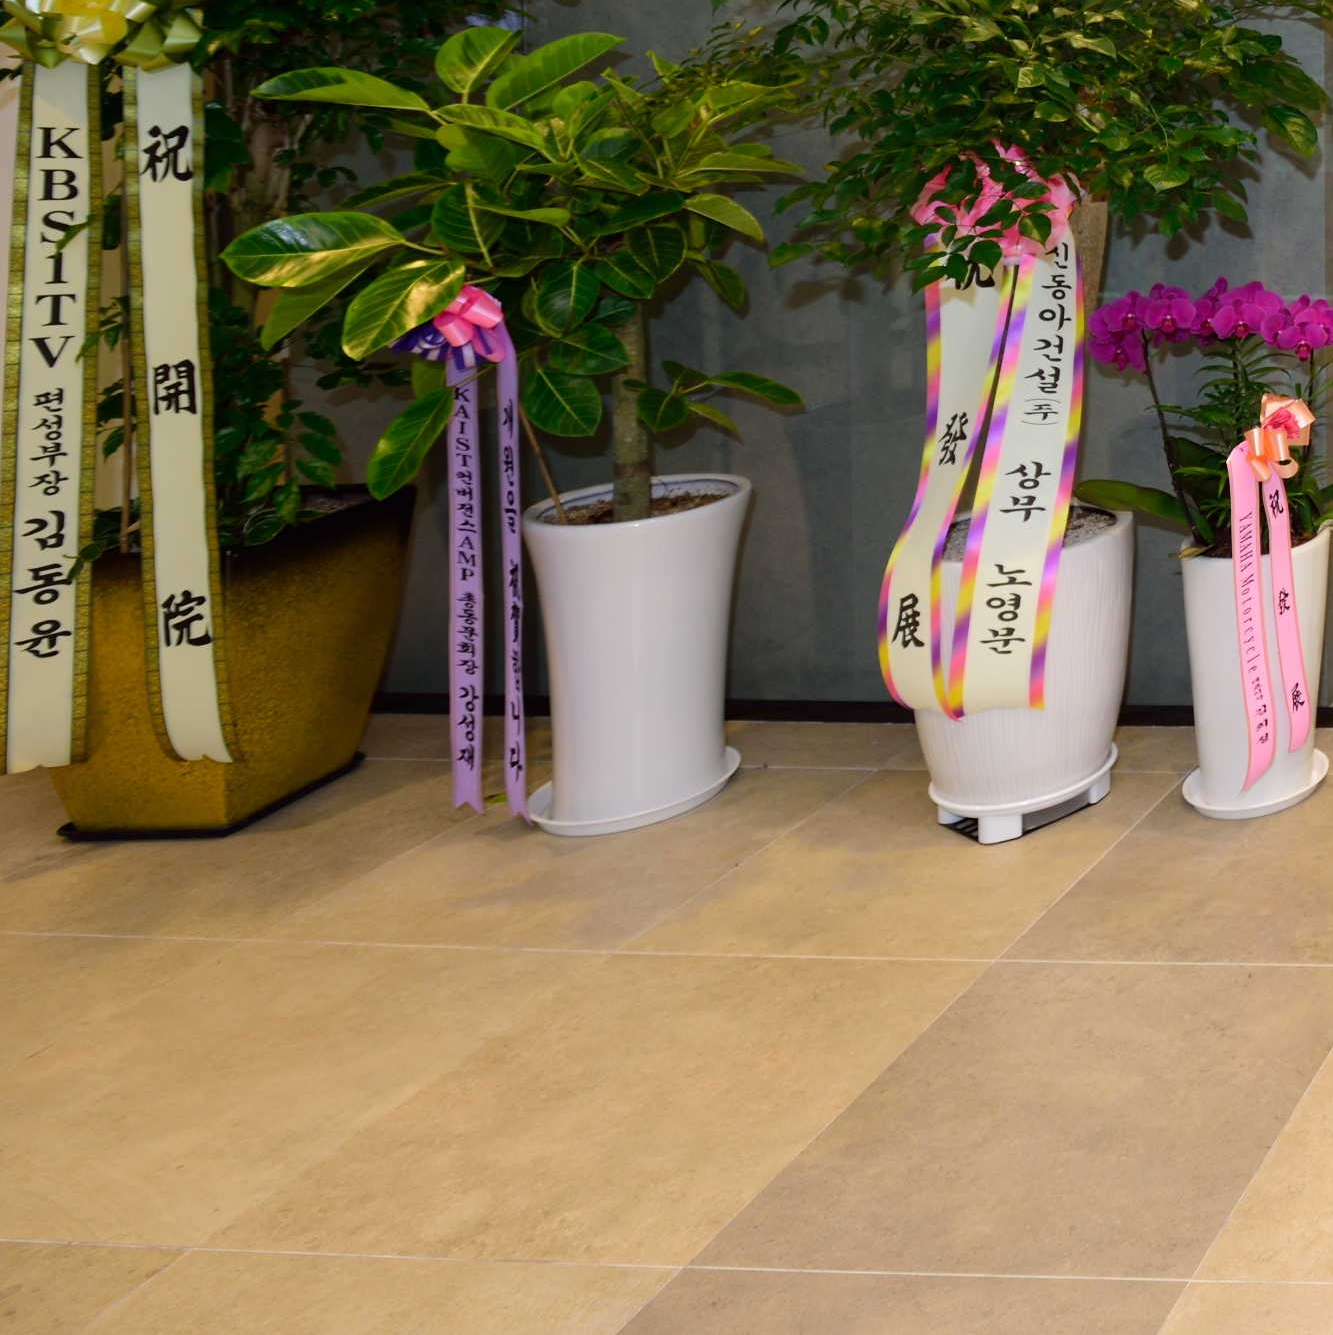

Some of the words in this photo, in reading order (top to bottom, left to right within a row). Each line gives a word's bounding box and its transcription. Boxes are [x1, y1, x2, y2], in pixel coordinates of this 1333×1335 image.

[29, 388, 68, 496] 편성부장
[1000, 462, 1051, 523] 상무
[13, 511, 72, 658] 김동윤
[1239, 512, 1254, 573] YAMAHA
[980, 563, 1033, 655] 노영문
[1241, 573, 1261, 674] Motorcycle
